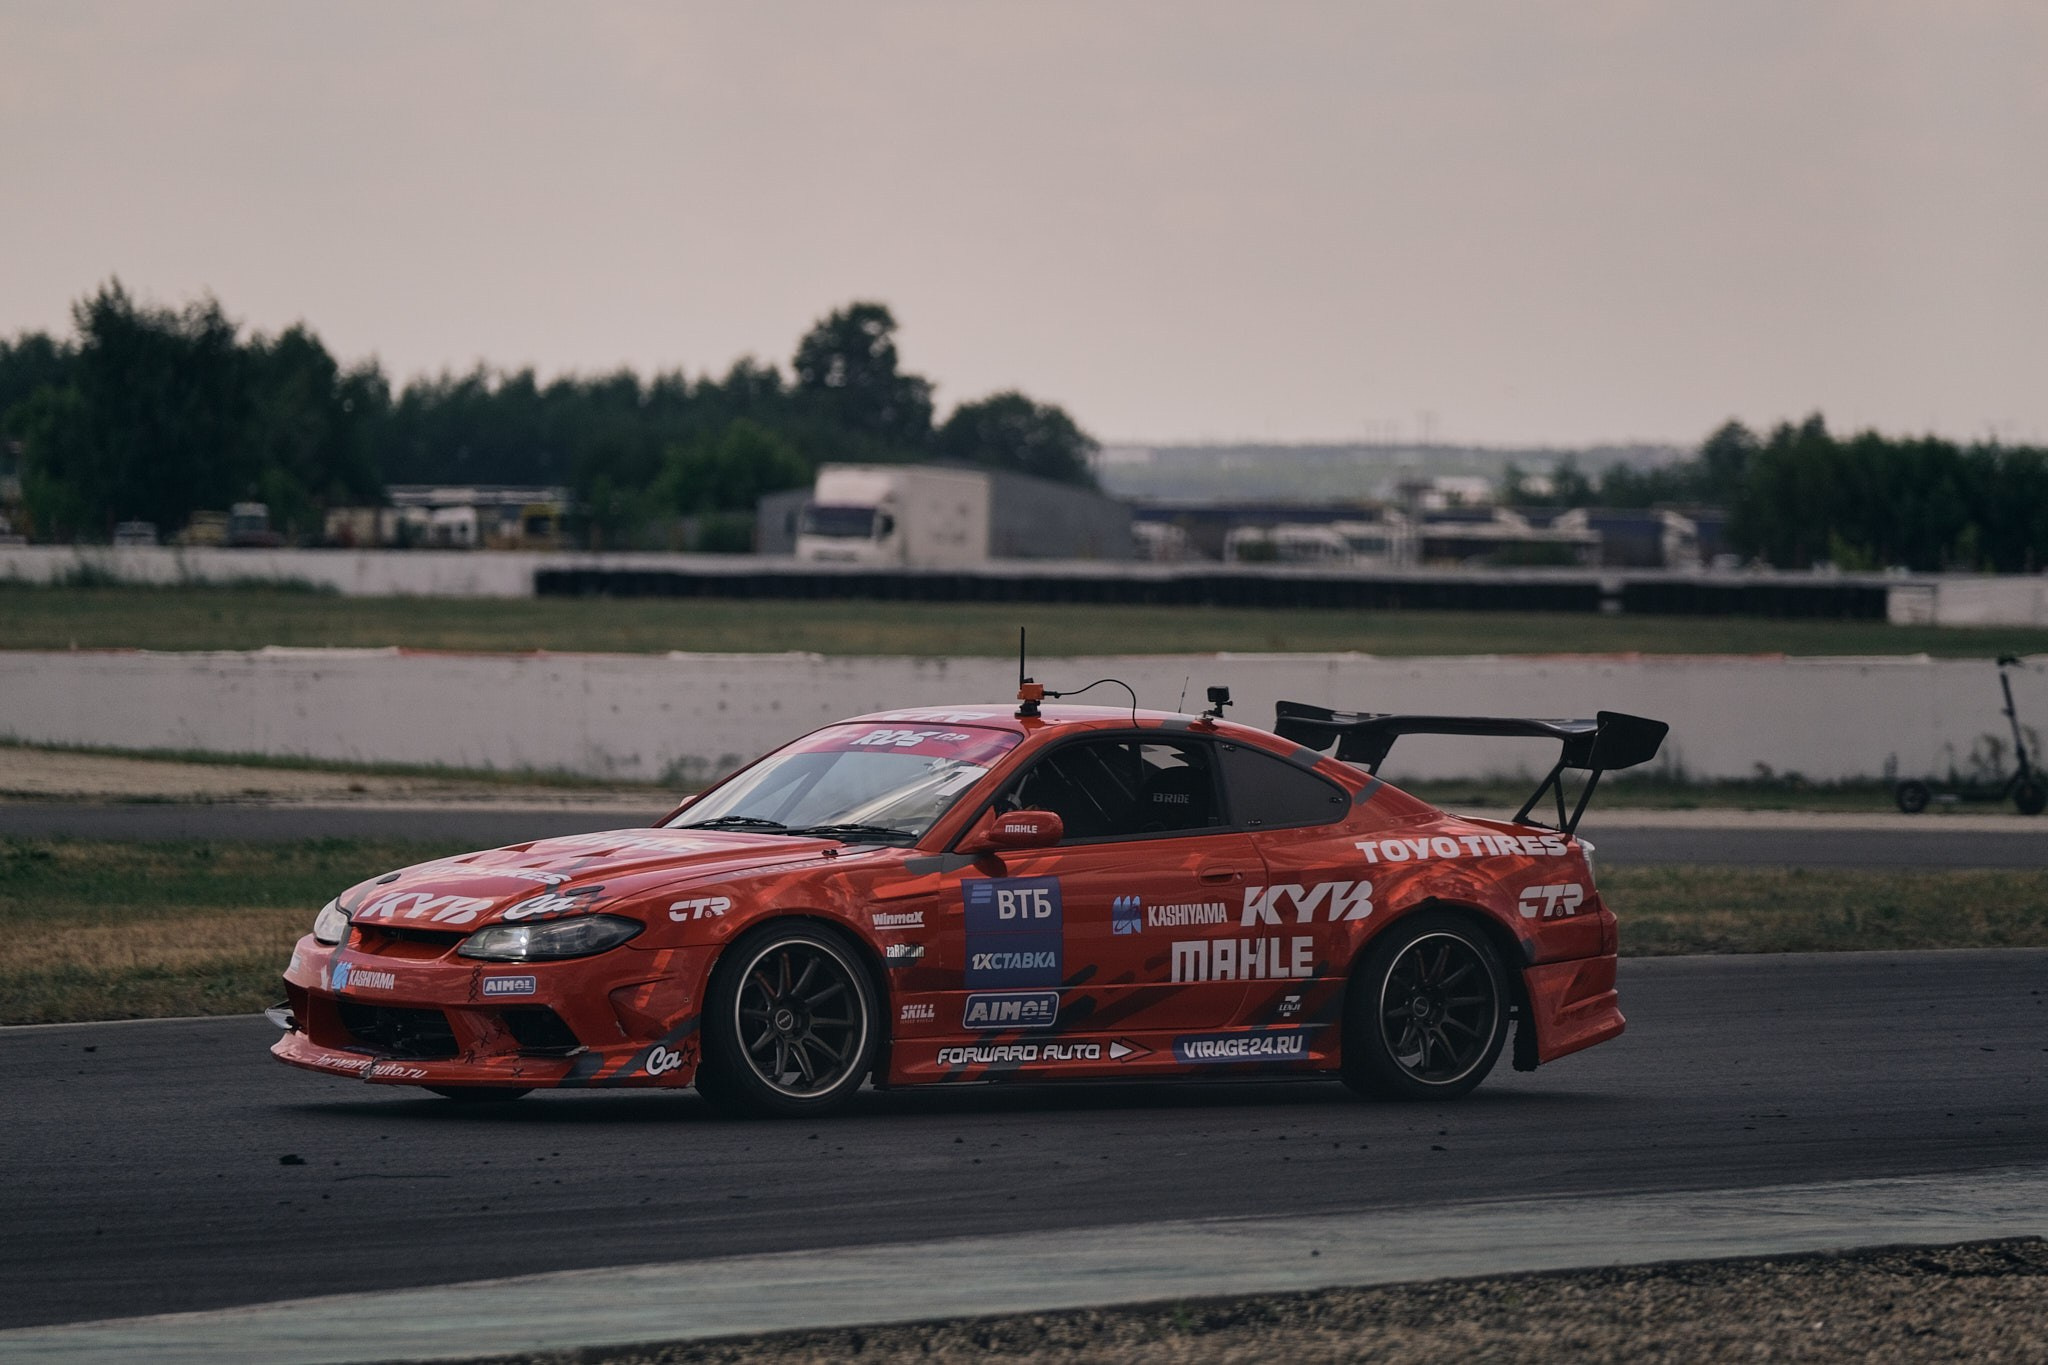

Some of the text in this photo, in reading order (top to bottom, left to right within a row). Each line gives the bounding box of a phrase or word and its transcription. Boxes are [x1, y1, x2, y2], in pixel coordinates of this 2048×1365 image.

[1153, 792, 1190, 804] BRIDE
[1005, 824, 1038, 834] MAHLE
[1355, 834, 1568, 863] TOYO TIRES
[358, 891, 496, 925] KYB
[669, 896, 732, 922] CTR
[998, 888, 1052, 920] ВТБ
[1240, 880, 1374, 927] KYB
[1518, 883, 1584, 919] CTR
[1147, 903, 1228, 927] KASHIYAMA
[1170, 936, 1314, 983] MAHLE
[347, 969, 396, 990] KASHIYAMA
[485, 978, 534, 993] AIMOL
[901, 1004, 935, 1019] SKILL
[968, 1000, 1053, 1023] AIMOL
[937, 1043, 1101, 1065] FORWARD AUTO
[1183, 1035, 1304, 1059] VIRAGE24.RU
